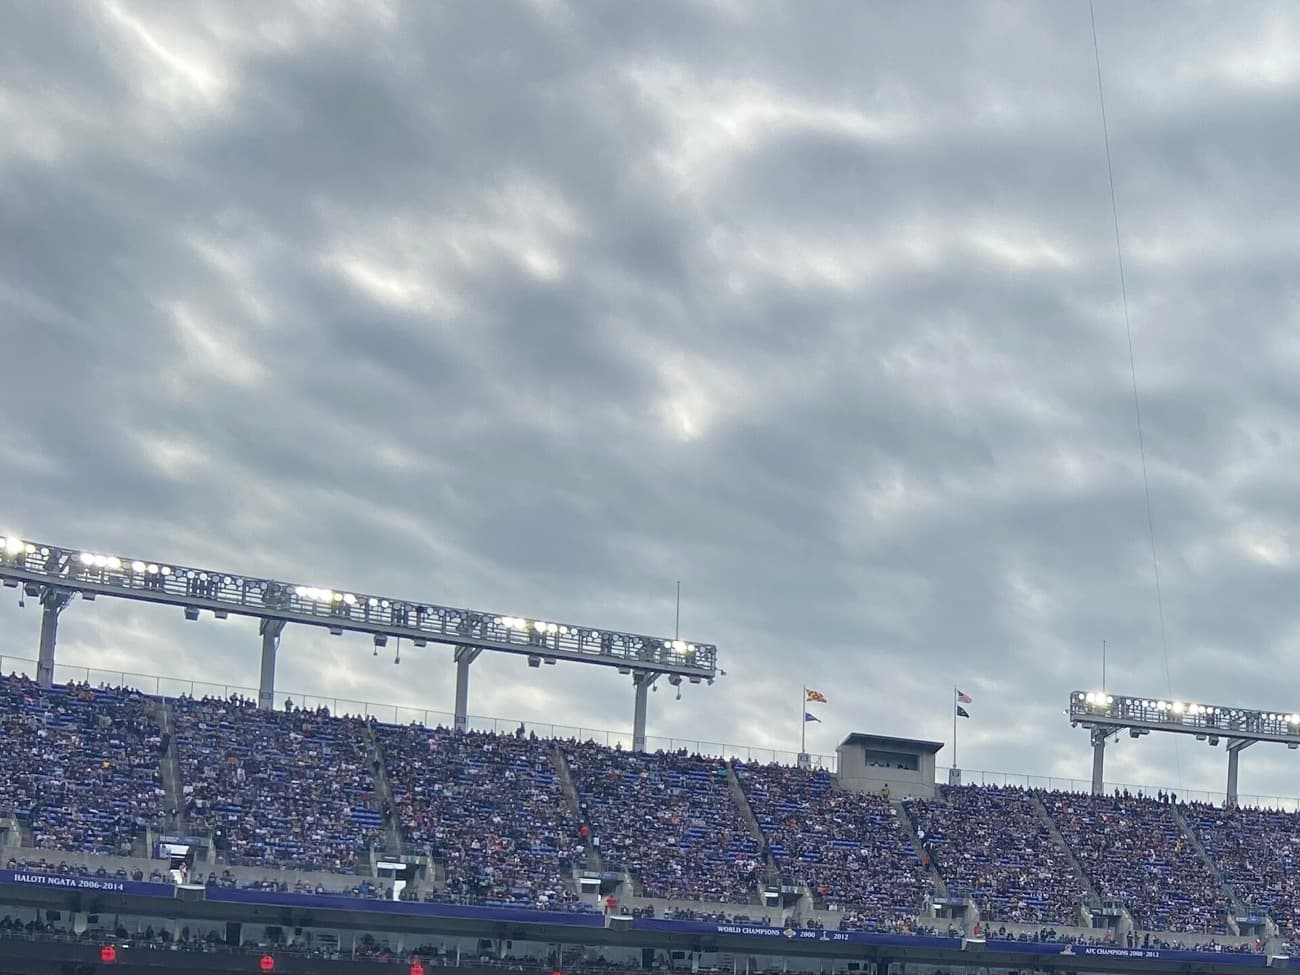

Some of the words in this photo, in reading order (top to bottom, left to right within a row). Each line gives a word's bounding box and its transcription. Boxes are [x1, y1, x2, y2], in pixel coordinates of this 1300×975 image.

[14, 873, 46, 884] HALOTI
[48, 877, 76, 887] NGATA
[78, 879, 124, 891] 2006-2014
[718, 925, 741, 934] WORLD
[742, 927, 780, 936] CHAMPIONS
